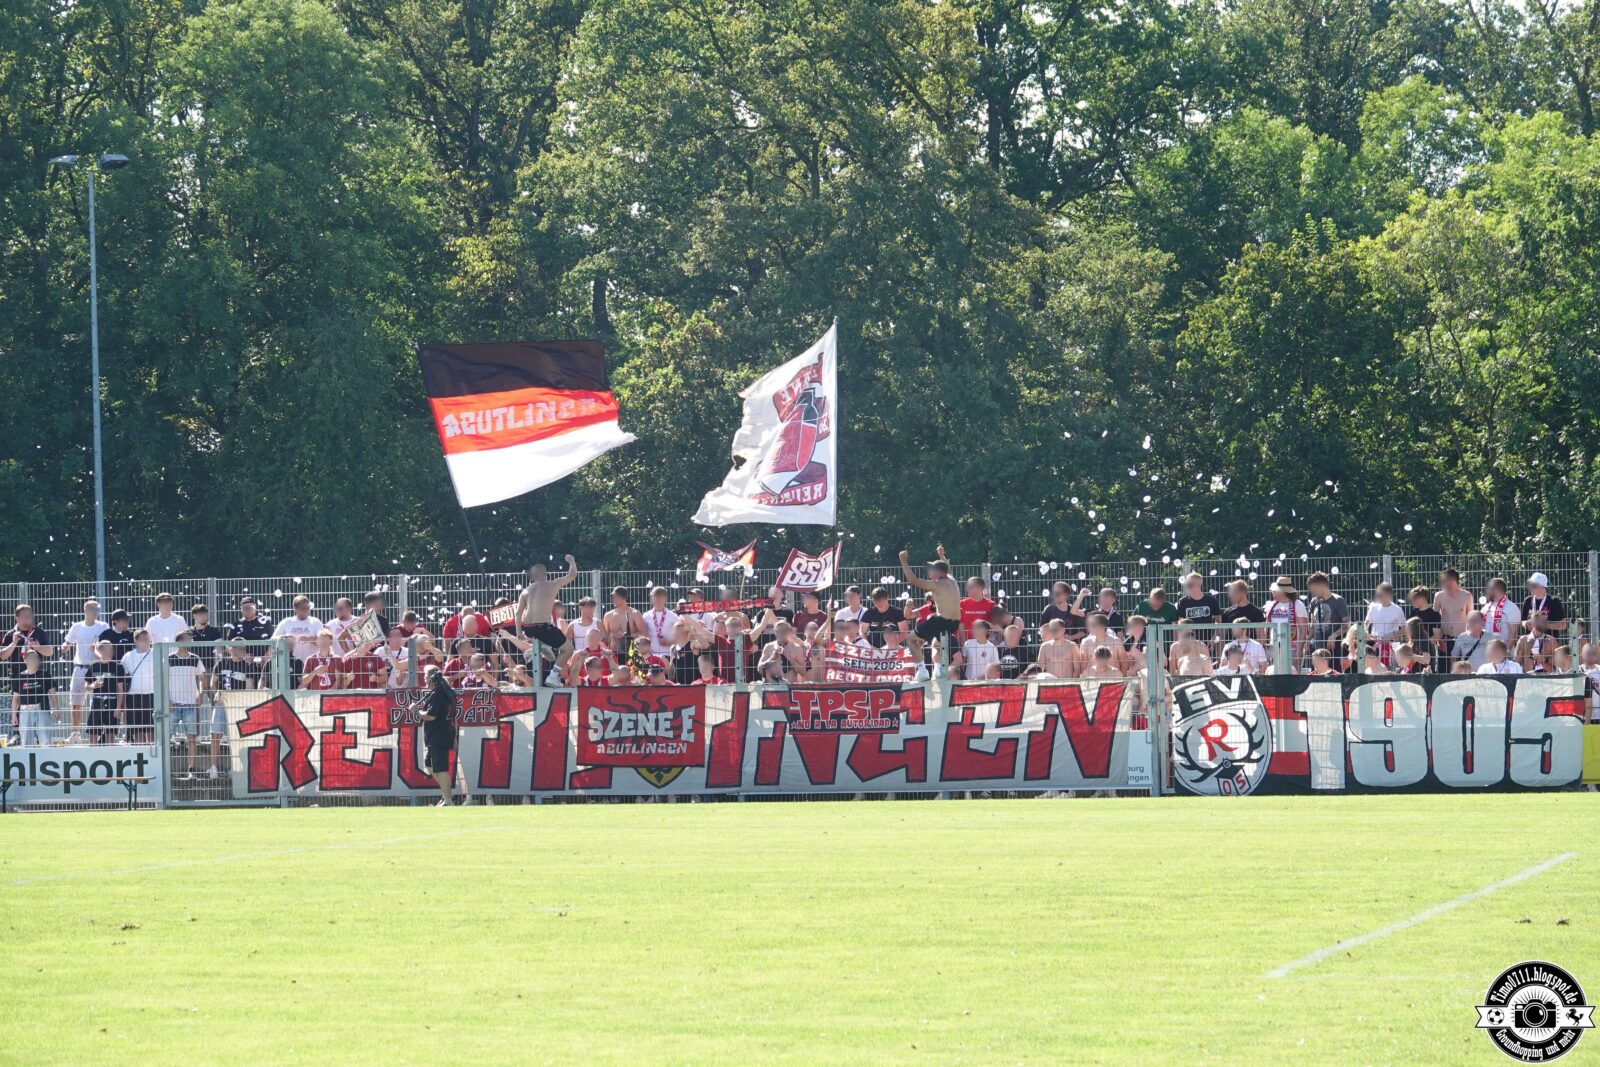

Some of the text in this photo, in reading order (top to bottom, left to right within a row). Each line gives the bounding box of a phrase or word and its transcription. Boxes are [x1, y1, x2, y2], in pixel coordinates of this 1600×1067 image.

[834, 642, 901, 659] SZENE
[844, 658, 903, 672] SEIT 2005
[791, 689, 896, 720] TPSP
[588, 705, 696, 743] SZENE E
[797, 719, 891, 729] NO A LA AUTORIDAD
[1294, 676, 1584, 790] 1905
[596, 742, 688, 755] REUTLINGEN
[1197, 718, 1240, 761] R
